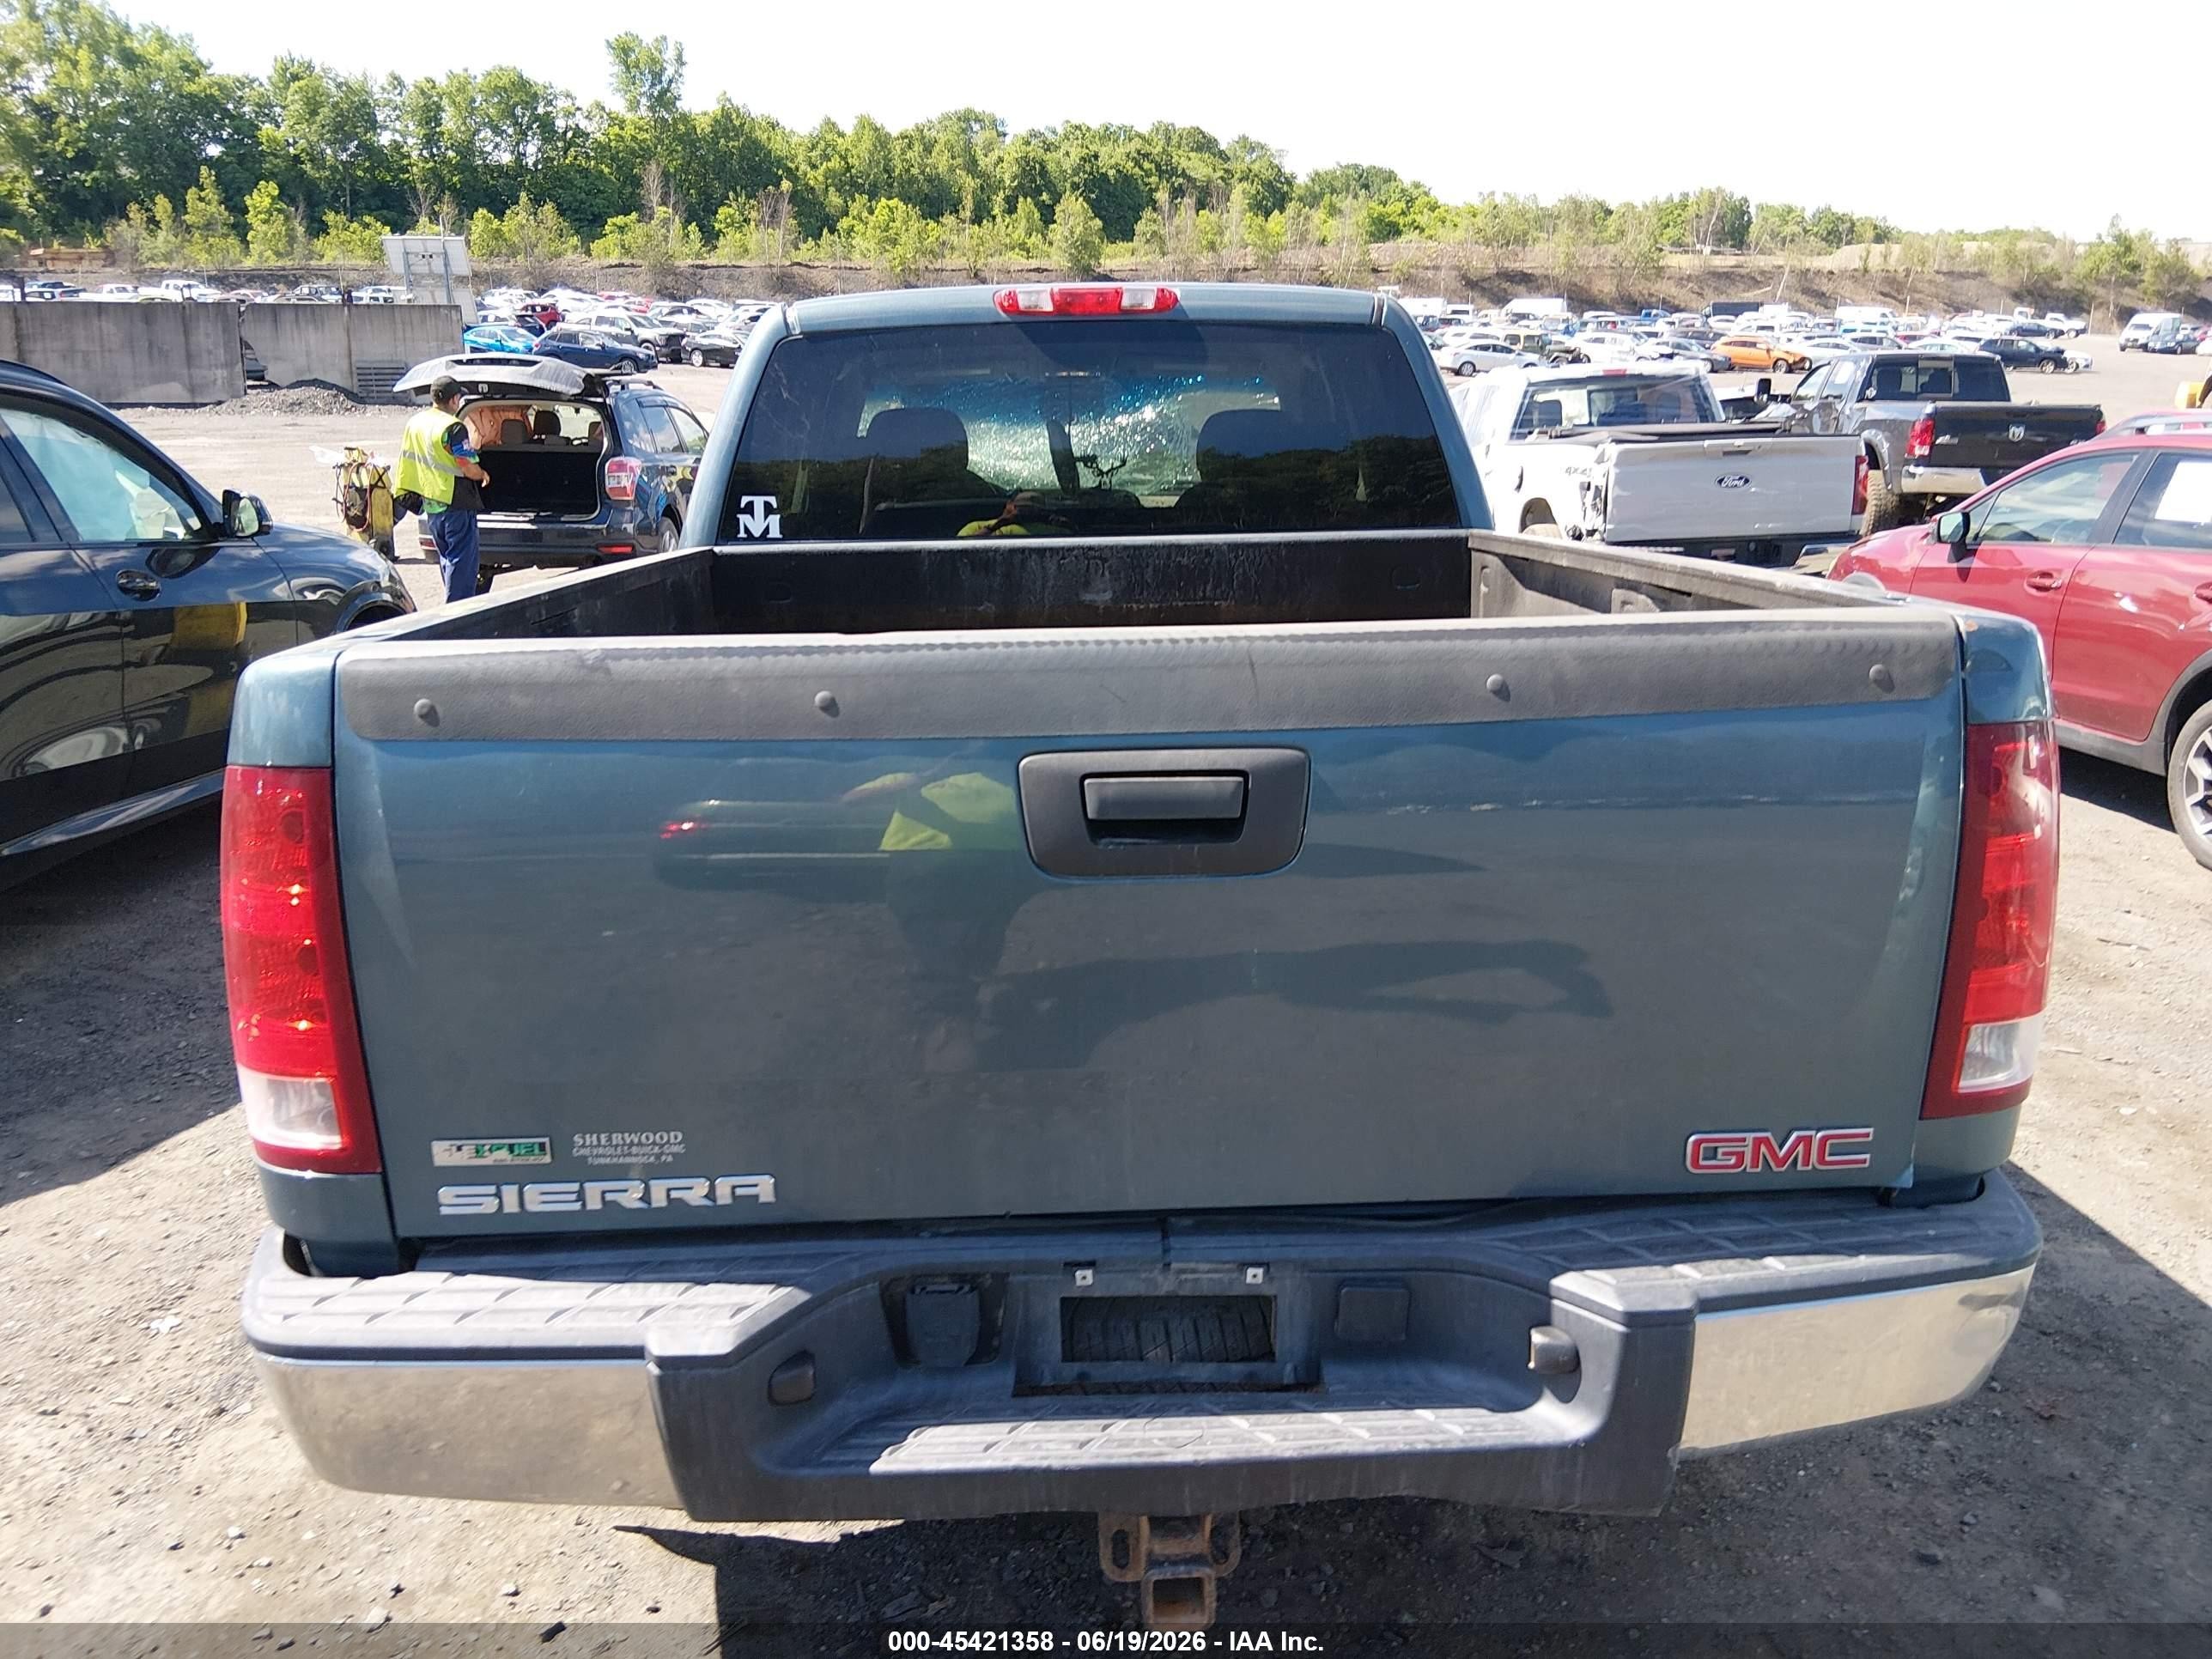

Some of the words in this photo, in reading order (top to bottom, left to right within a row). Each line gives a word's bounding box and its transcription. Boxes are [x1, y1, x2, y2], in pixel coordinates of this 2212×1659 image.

[573, 1131, 684, 1147] SHERWOOD
[1686, 1127, 1875, 1174] GMC
[436, 1173, 776, 1216] SIERRA
